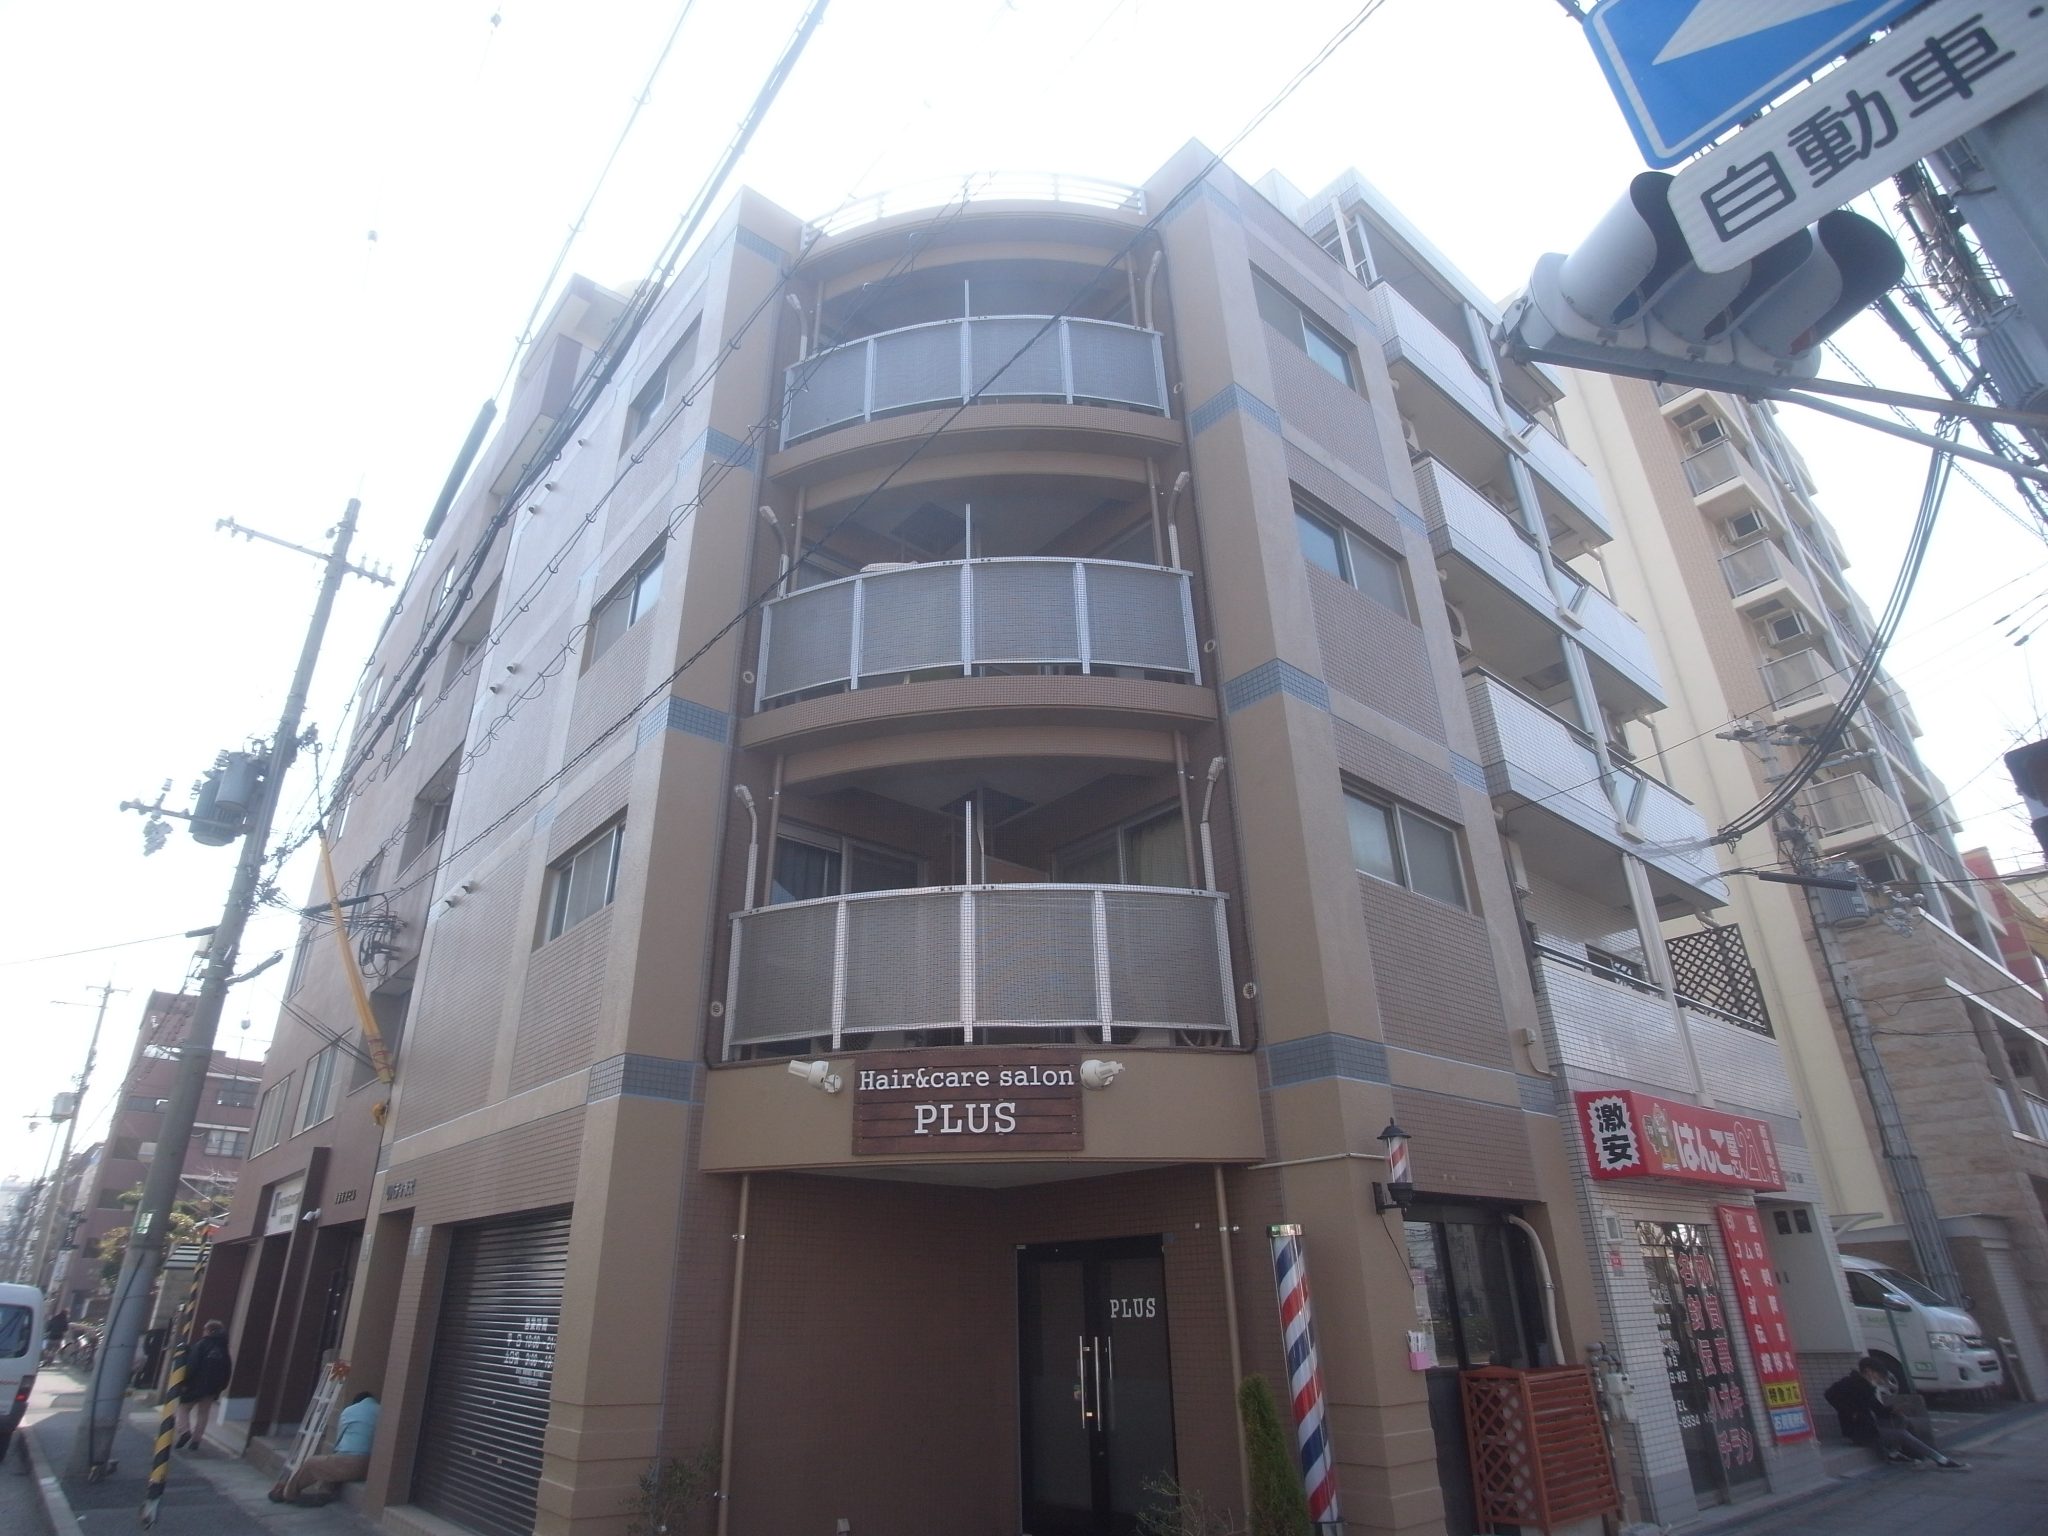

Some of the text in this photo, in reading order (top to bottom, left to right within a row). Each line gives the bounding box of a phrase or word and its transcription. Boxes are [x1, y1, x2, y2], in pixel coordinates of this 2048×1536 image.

[859, 1066, 1074, 1091] Hair&care salon
[914, 1103, 1016, 1134] PLUS
[1595, 1102, 1633, 1165] 激安
[1110, 1299, 1156, 1318] PLUS
